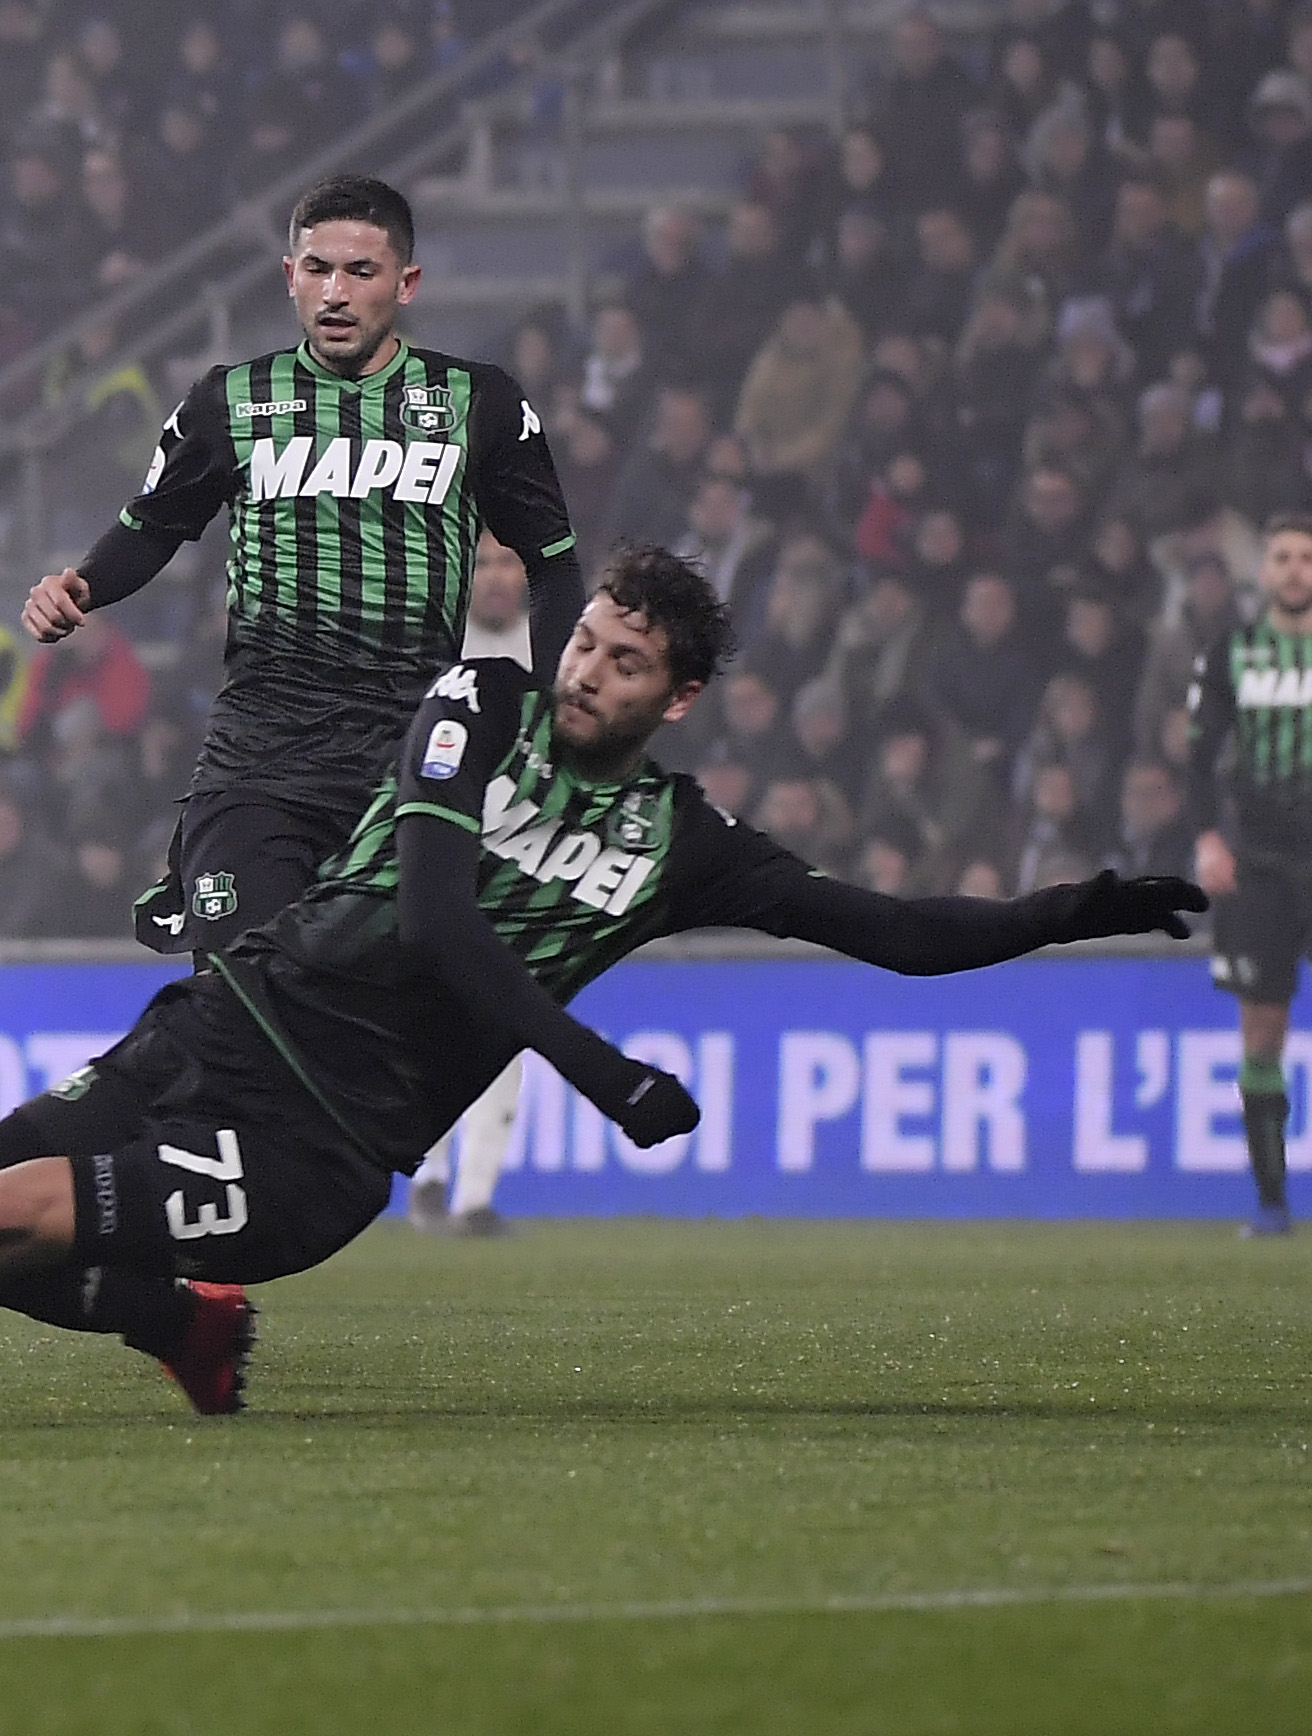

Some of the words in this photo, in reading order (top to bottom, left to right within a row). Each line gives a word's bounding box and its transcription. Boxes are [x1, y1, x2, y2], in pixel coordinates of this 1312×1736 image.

[236, 400, 306, 417] Kappa
[250, 437, 461, 505] MAPEI
[482, 774, 656, 916] MAPEI
[778, 1030, 1028, 1173] PER
[157, 1129, 248, 1240] 73
